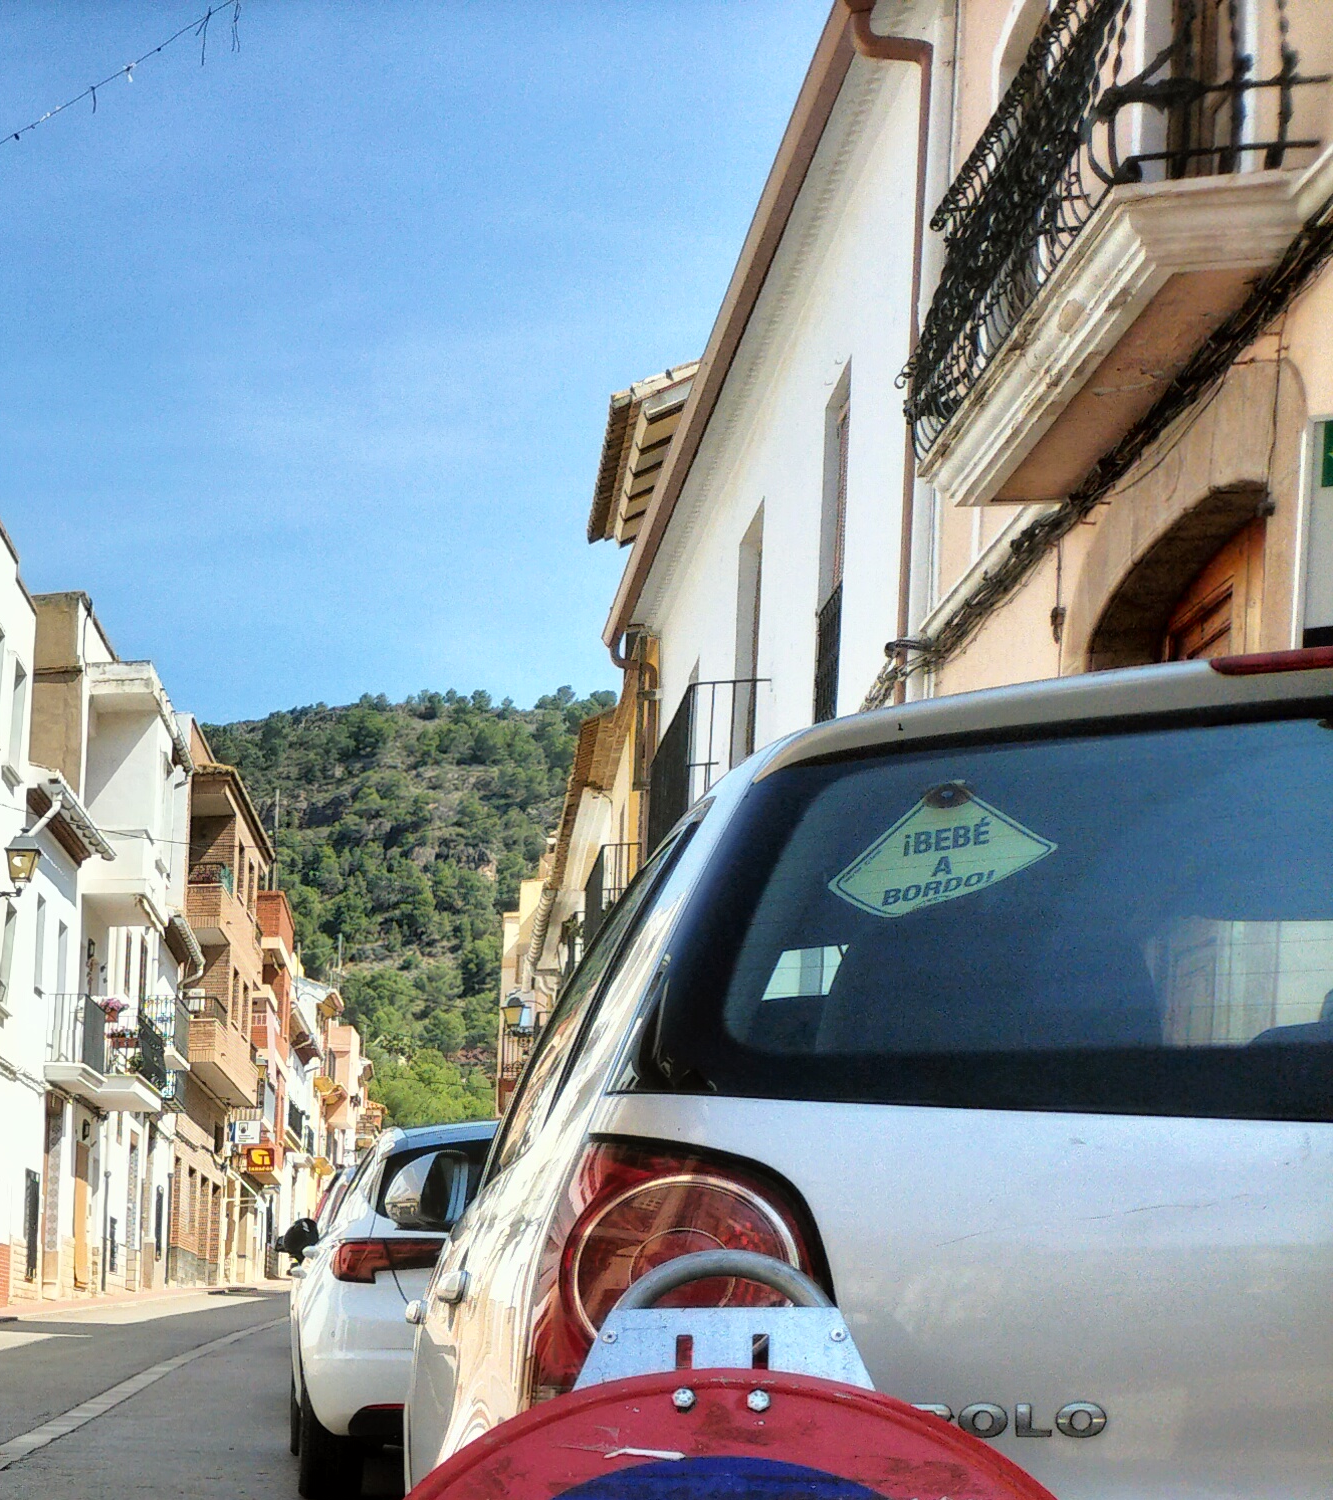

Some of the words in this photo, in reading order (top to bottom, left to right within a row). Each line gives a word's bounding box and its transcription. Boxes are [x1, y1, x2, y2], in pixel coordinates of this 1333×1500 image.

[903, 816, 993, 857] ¡BEBÉ
[930, 855, 953, 878] A
[882, 870, 997, 907] BORDO!
